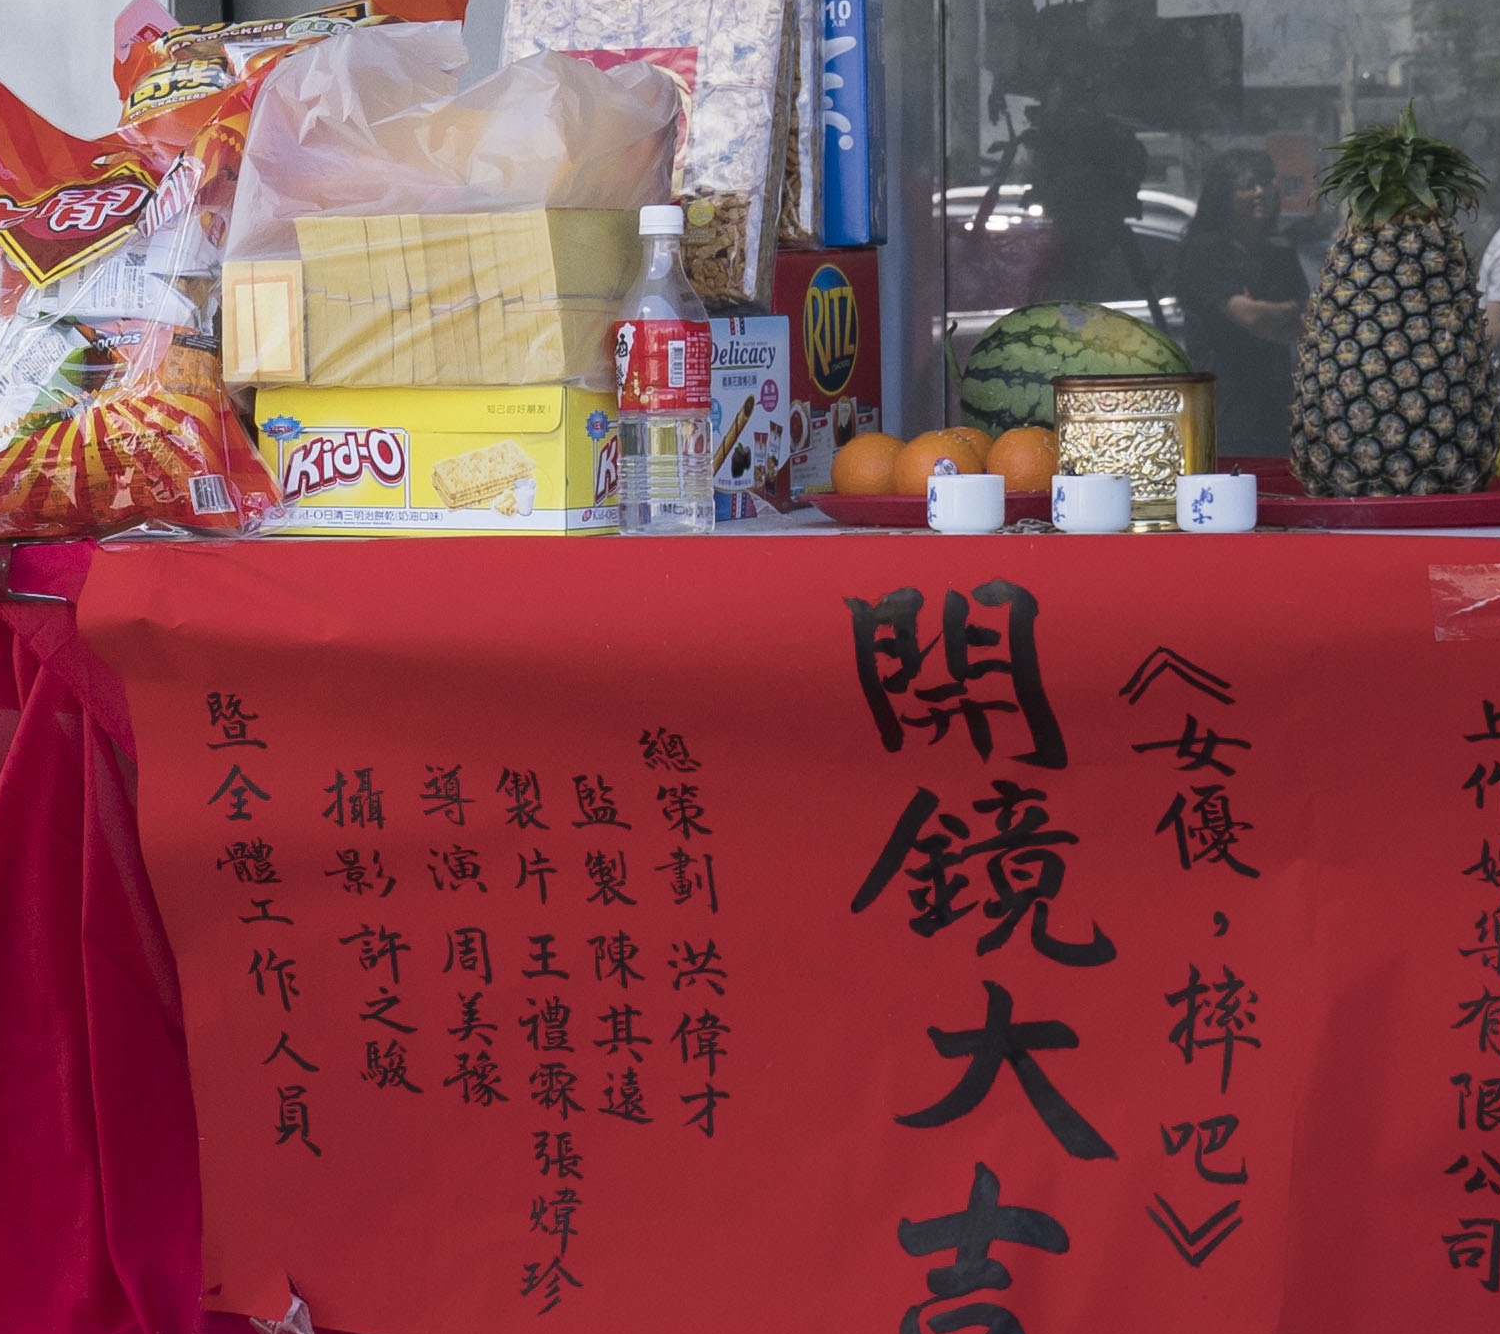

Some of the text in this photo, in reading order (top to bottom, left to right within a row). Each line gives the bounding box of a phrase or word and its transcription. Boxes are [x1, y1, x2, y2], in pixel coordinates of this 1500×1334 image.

[92, 332, 142, 351] oritos
[807, 286, 855, 380] RITZ
[283, 428, 407, 505] Kid-O
[207, 692, 322, 1158] 暨全體工作人員
